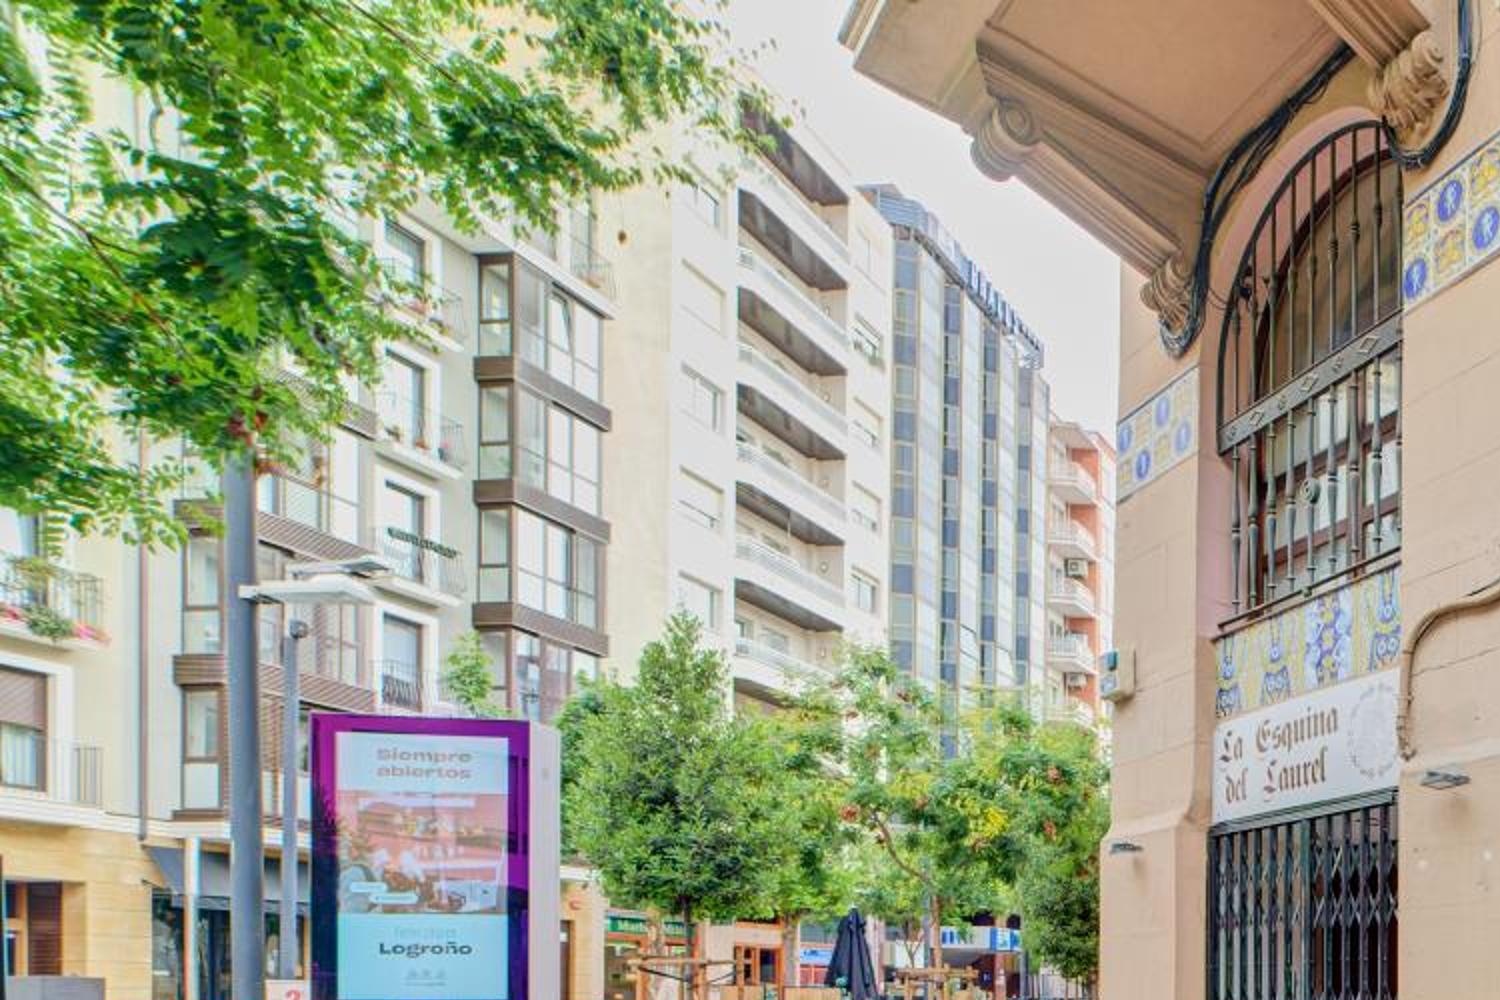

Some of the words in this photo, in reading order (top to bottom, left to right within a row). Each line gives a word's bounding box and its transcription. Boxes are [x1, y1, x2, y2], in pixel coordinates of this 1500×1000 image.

[1218, 731, 1243, 763] La
[1255, 706, 1339, 753] Esquina
[376, 747, 473, 763] Siempre
[376, 765, 473, 780] abiertos
[1224, 768, 1249, 804] del
[1263, 745, 1329, 794] Laurel
[378, 941, 473, 959] Logroño
